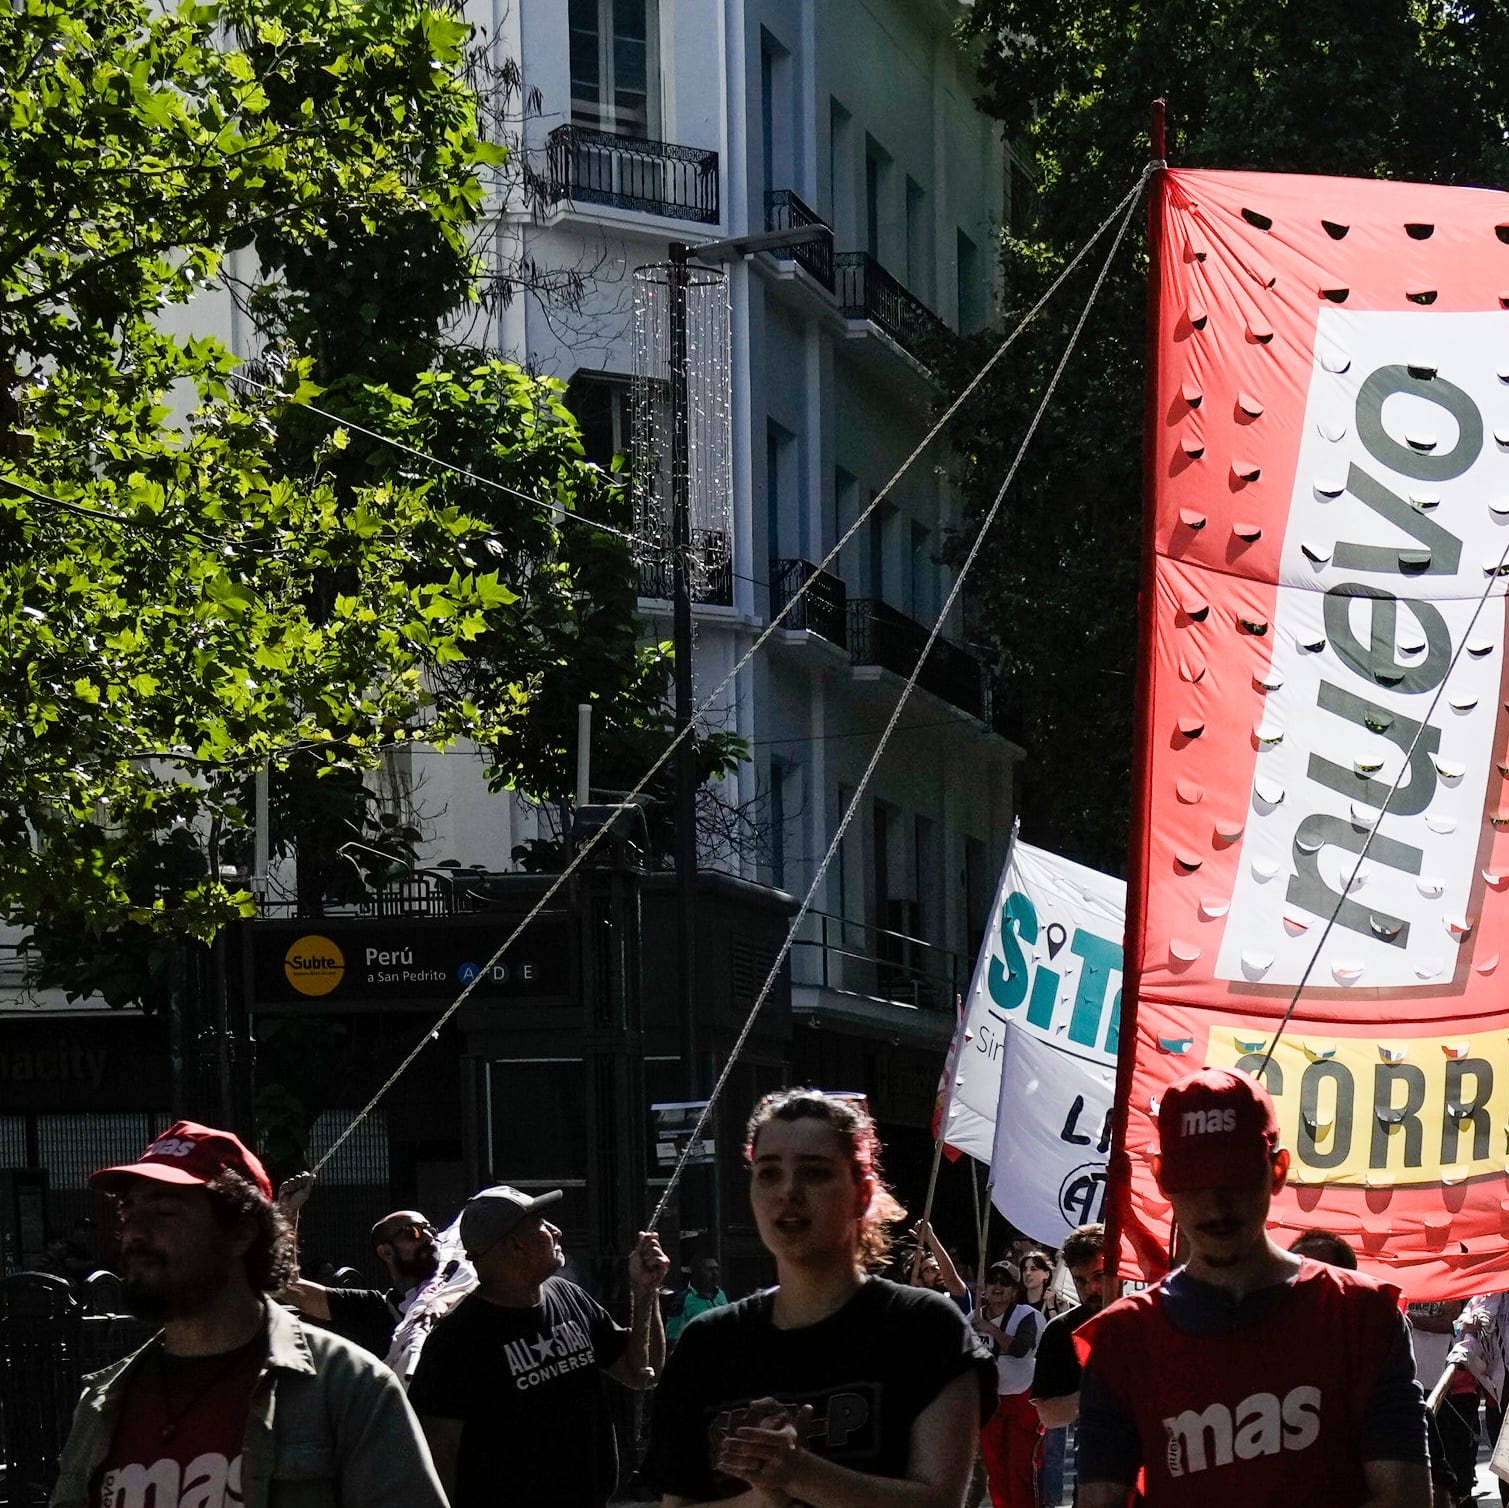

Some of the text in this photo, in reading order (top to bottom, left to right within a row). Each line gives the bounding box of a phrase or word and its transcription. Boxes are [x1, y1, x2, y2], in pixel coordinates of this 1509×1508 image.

[1285, 365, 1484, 948] nuevo
[293, 955, 336, 969] Subte
[365, 946, 414, 967] Perú
[367, 974, 375, 983] a
[377, 972, 400, 983] San
[403, 970, 447, 982] Pedrito
[1180, 1108, 1237, 1137] mas
[503, 1338, 541, 1376] ALL
[516, 1350, 596, 1391] CONVERSE
[1161, 1385, 1323, 1478] mas
